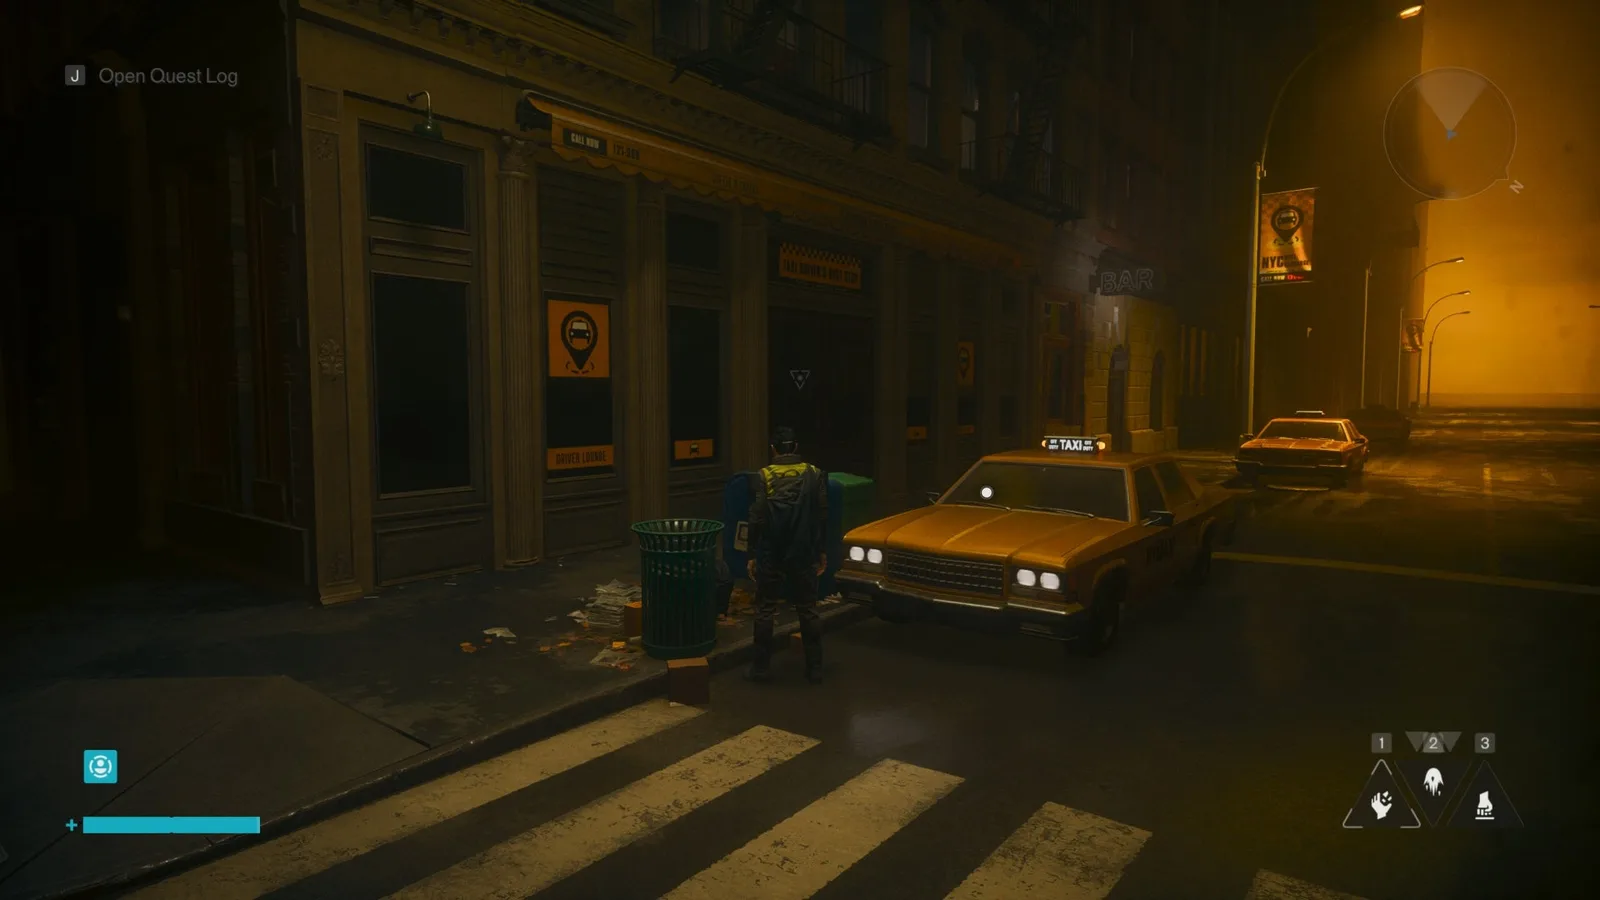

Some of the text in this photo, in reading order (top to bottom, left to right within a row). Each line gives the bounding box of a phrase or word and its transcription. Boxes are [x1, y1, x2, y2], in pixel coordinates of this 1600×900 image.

[1262, 256, 1284, 268] NYC
[1100, 268, 1154, 293] BAR
[1060, 438, 1083, 451] TAXI
[556, 450, 607, 465] DRIVER LOUNGE
